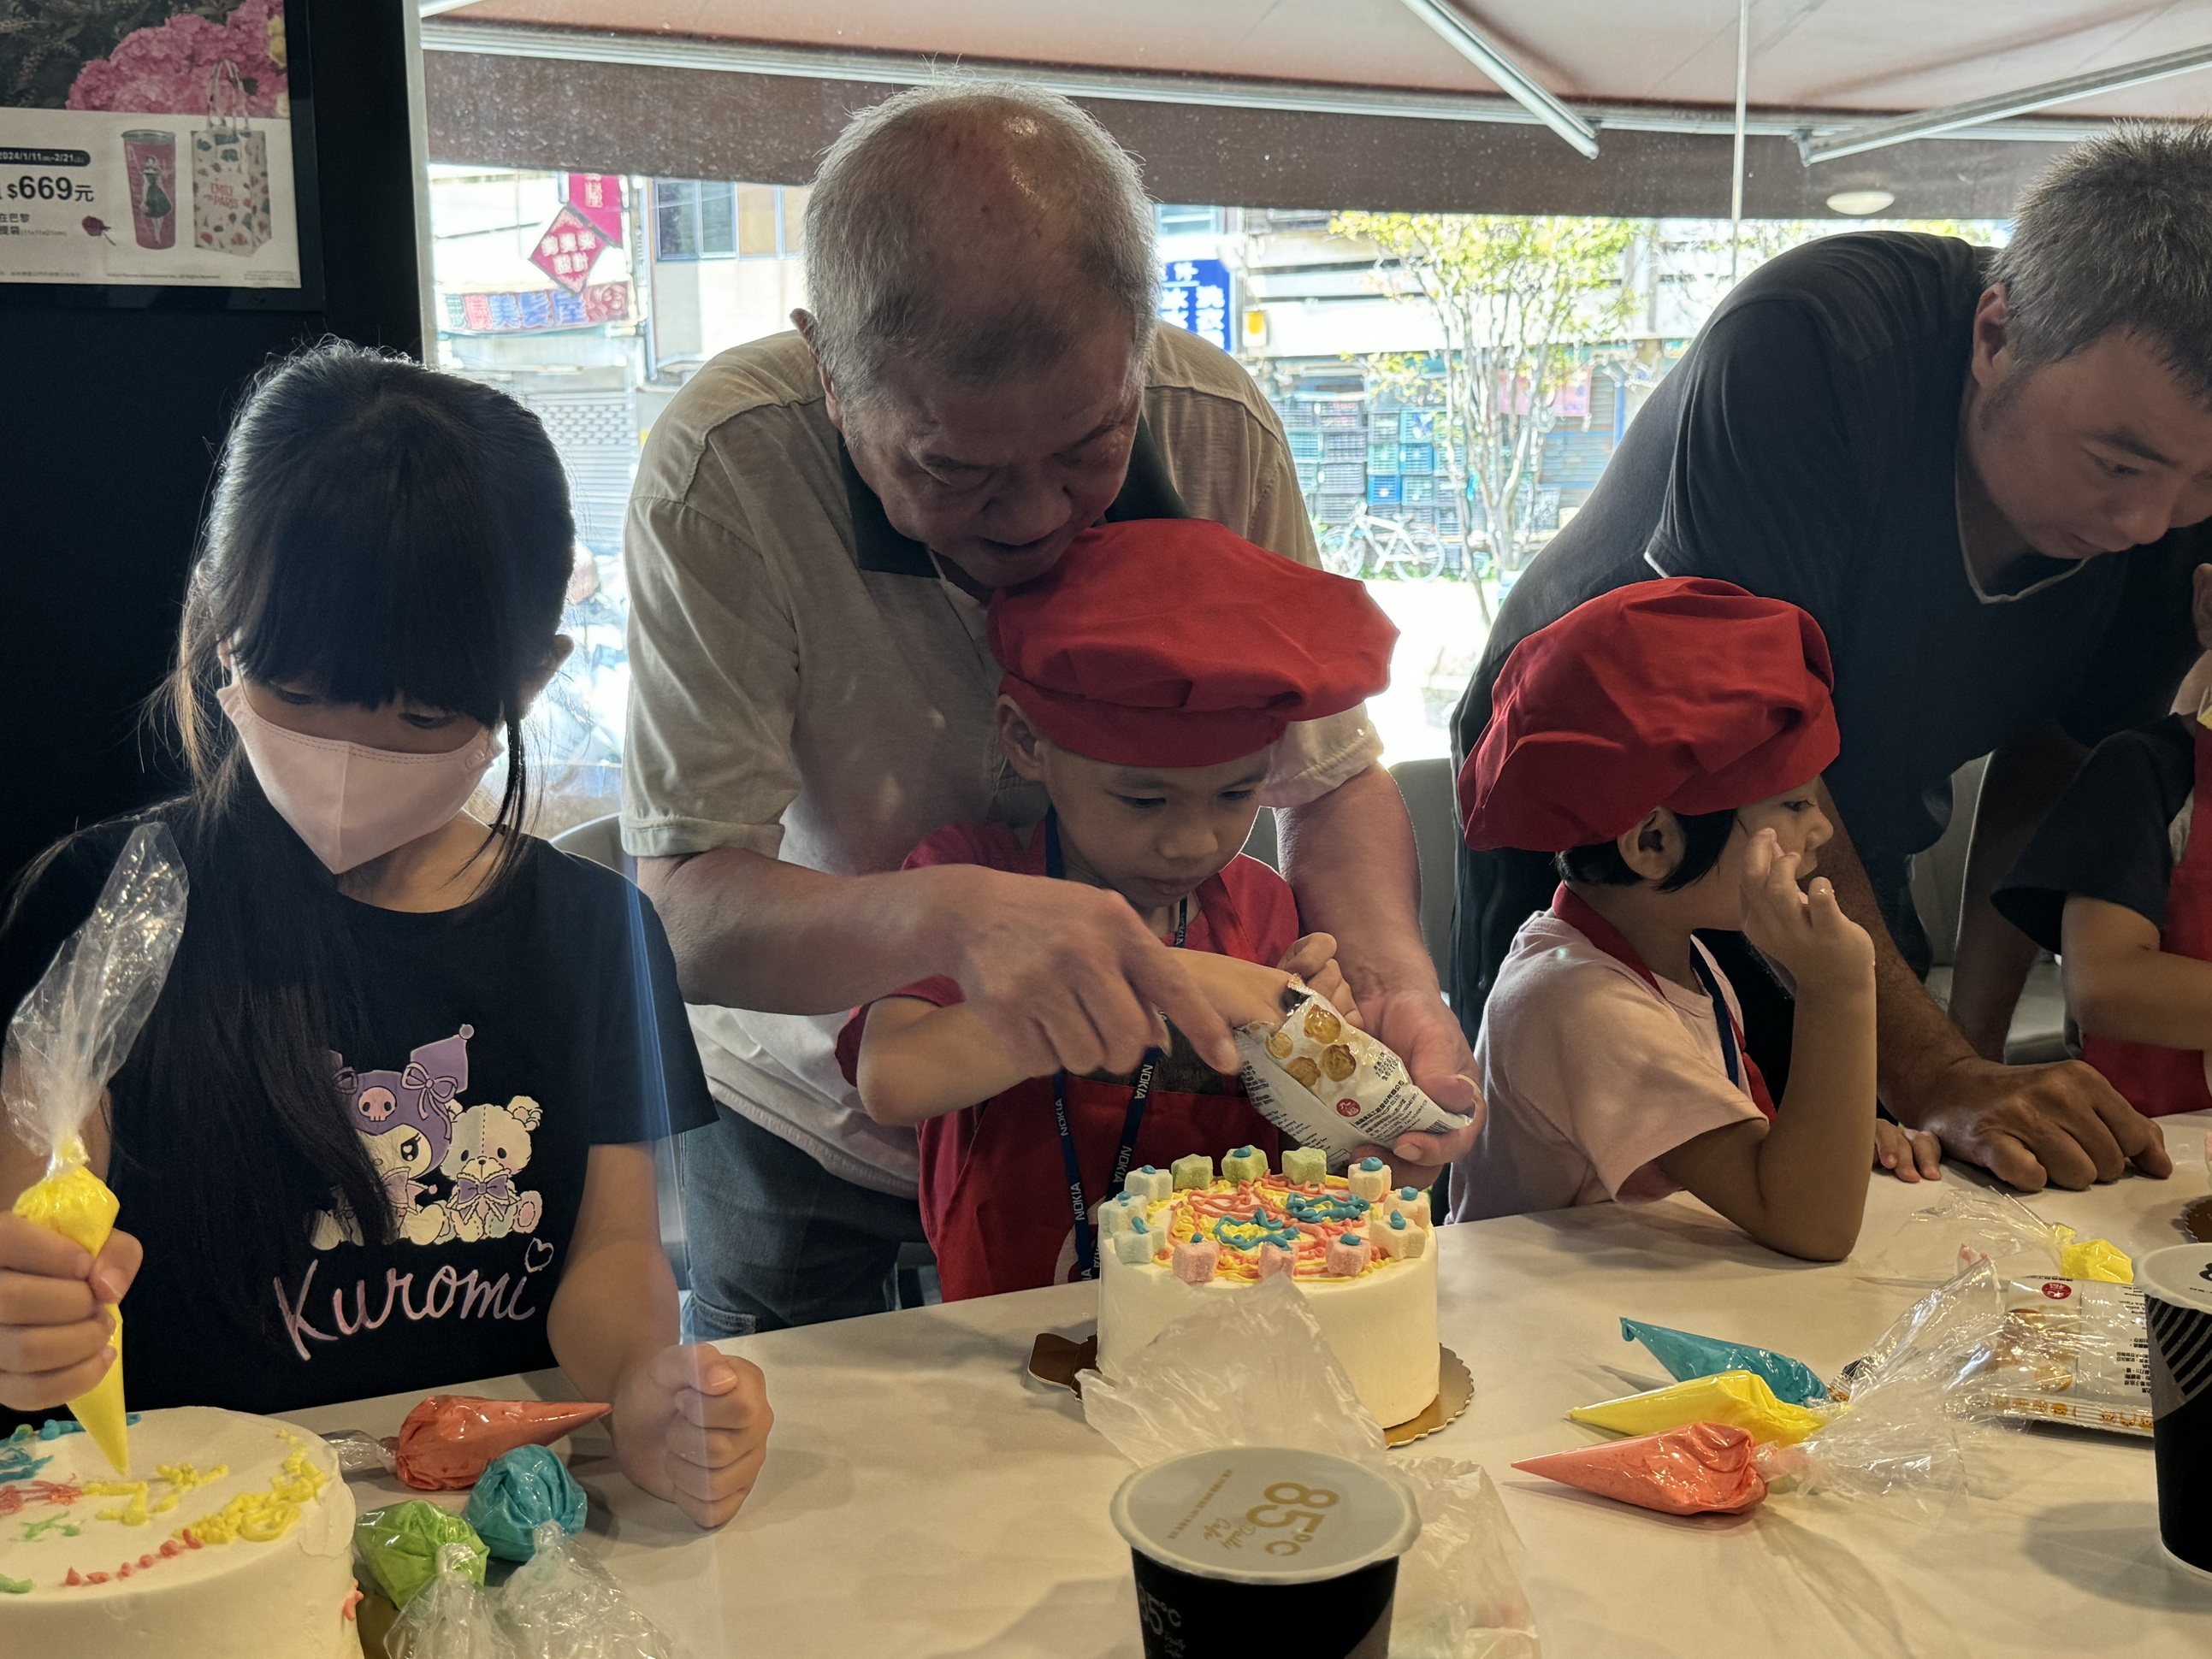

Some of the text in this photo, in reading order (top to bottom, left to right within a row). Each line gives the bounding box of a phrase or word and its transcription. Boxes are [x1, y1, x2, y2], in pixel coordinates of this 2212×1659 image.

[1134, 1064, 1154, 1100] NOKIA
[1055, 1098, 1069, 1137] NOKIA
[1113, 1145, 1133, 1184] NOKIA
[1070, 1182, 1085, 1220] NOKIA
[273, 1237, 553, 1361] Kuromi
[1221, 1524, 1257, 1550] Daily
